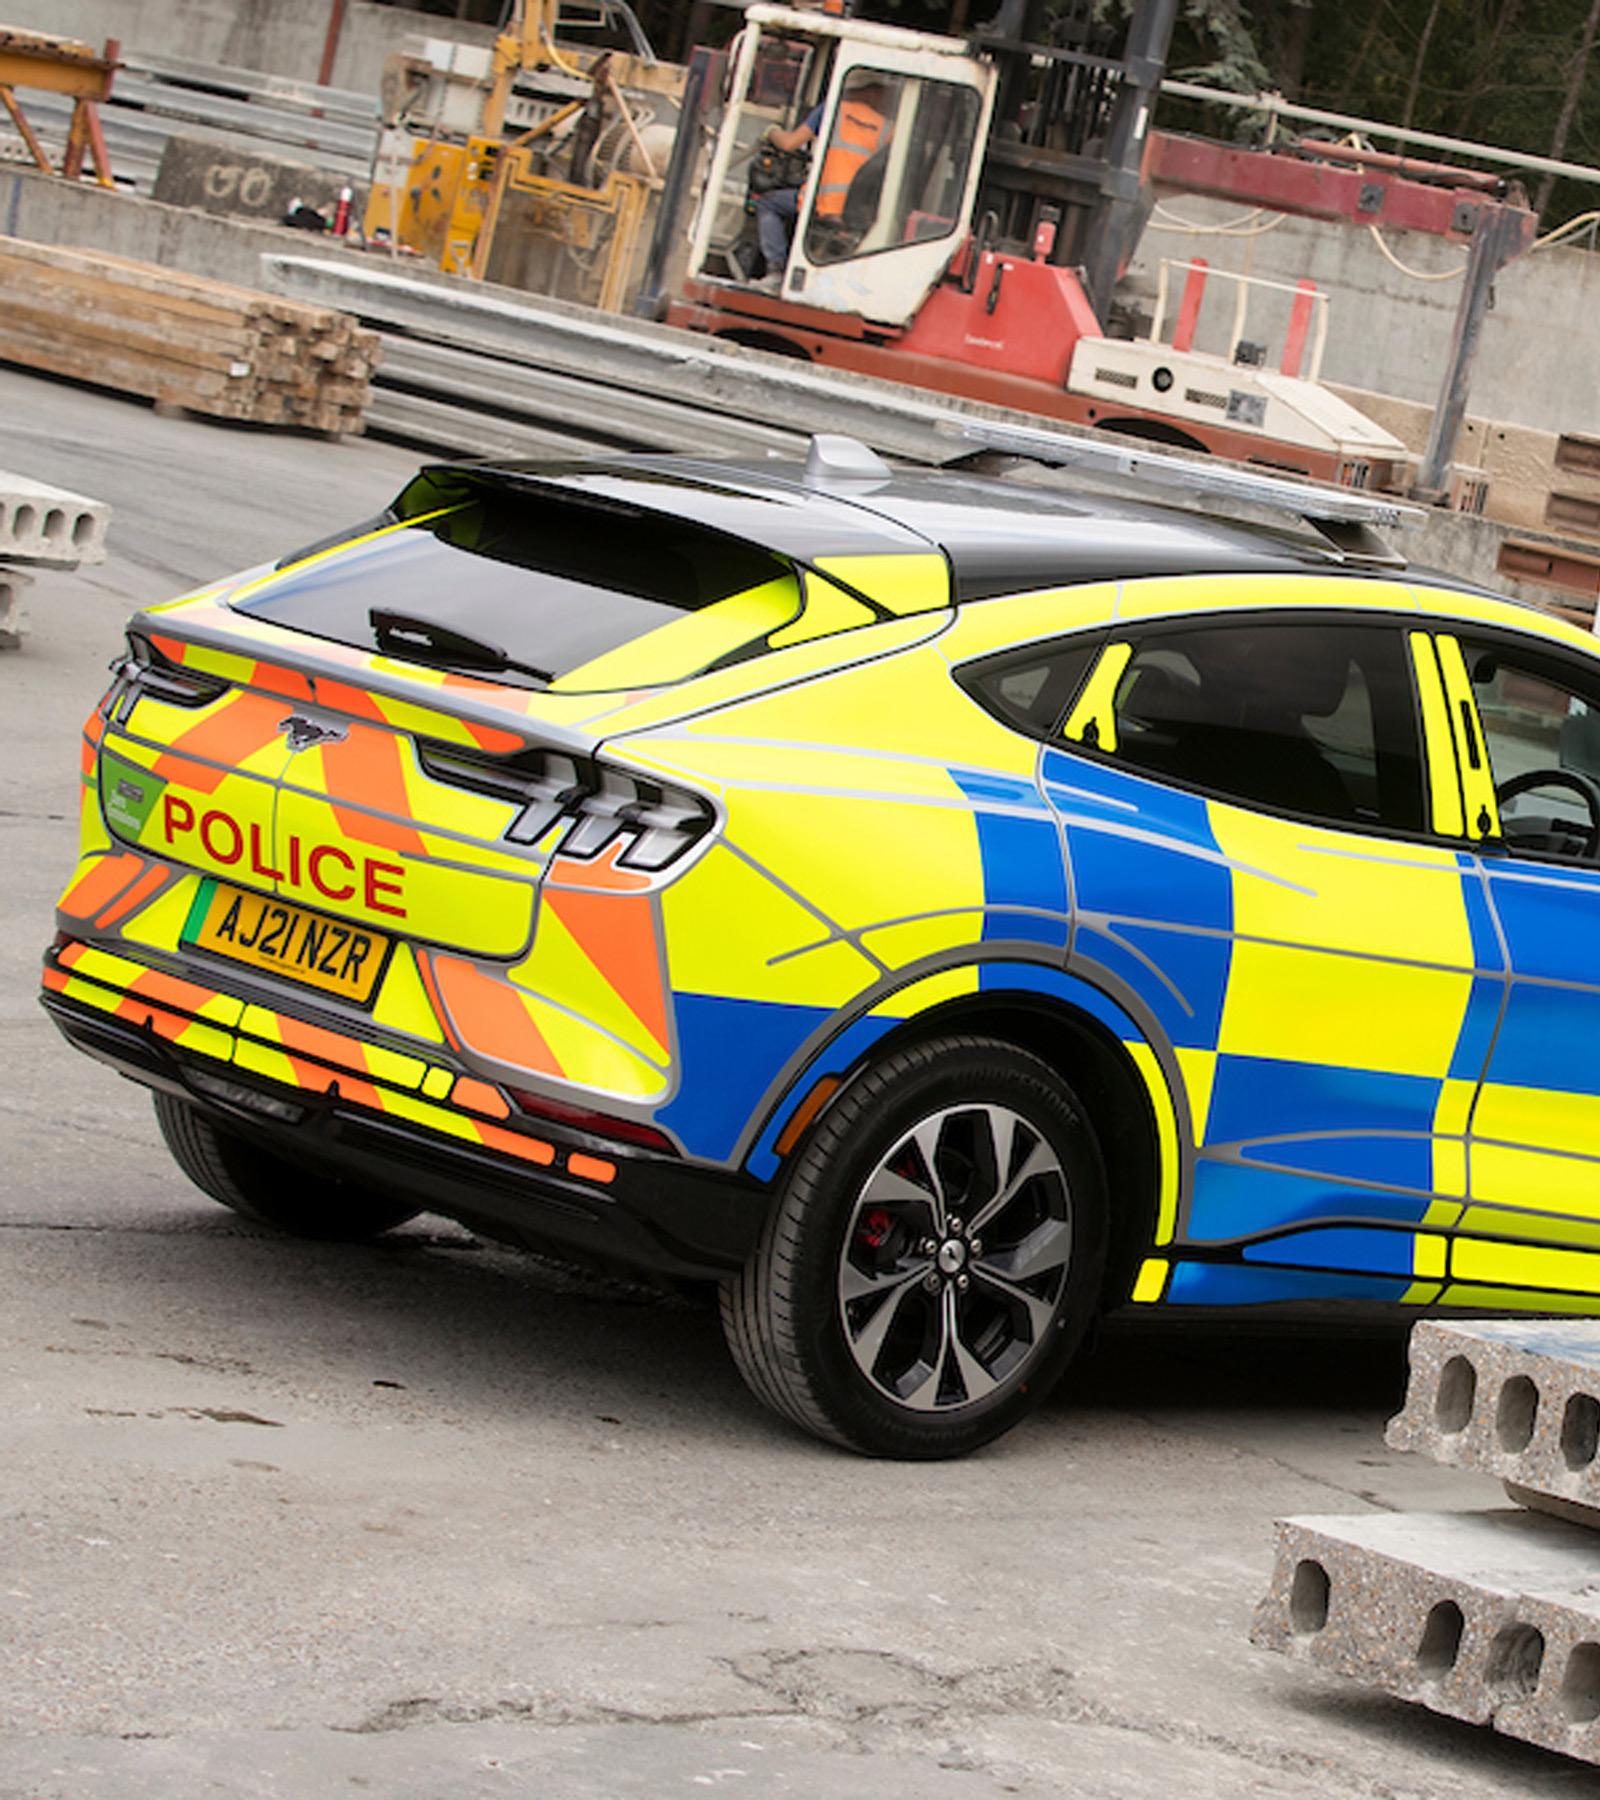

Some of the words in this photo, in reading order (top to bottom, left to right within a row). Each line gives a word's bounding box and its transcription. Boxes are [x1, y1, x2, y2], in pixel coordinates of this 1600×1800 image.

[163, 794, 407, 917] POLICE
[215, 895, 299, 959] AJ21
[296, 919, 371, 983] NZR
